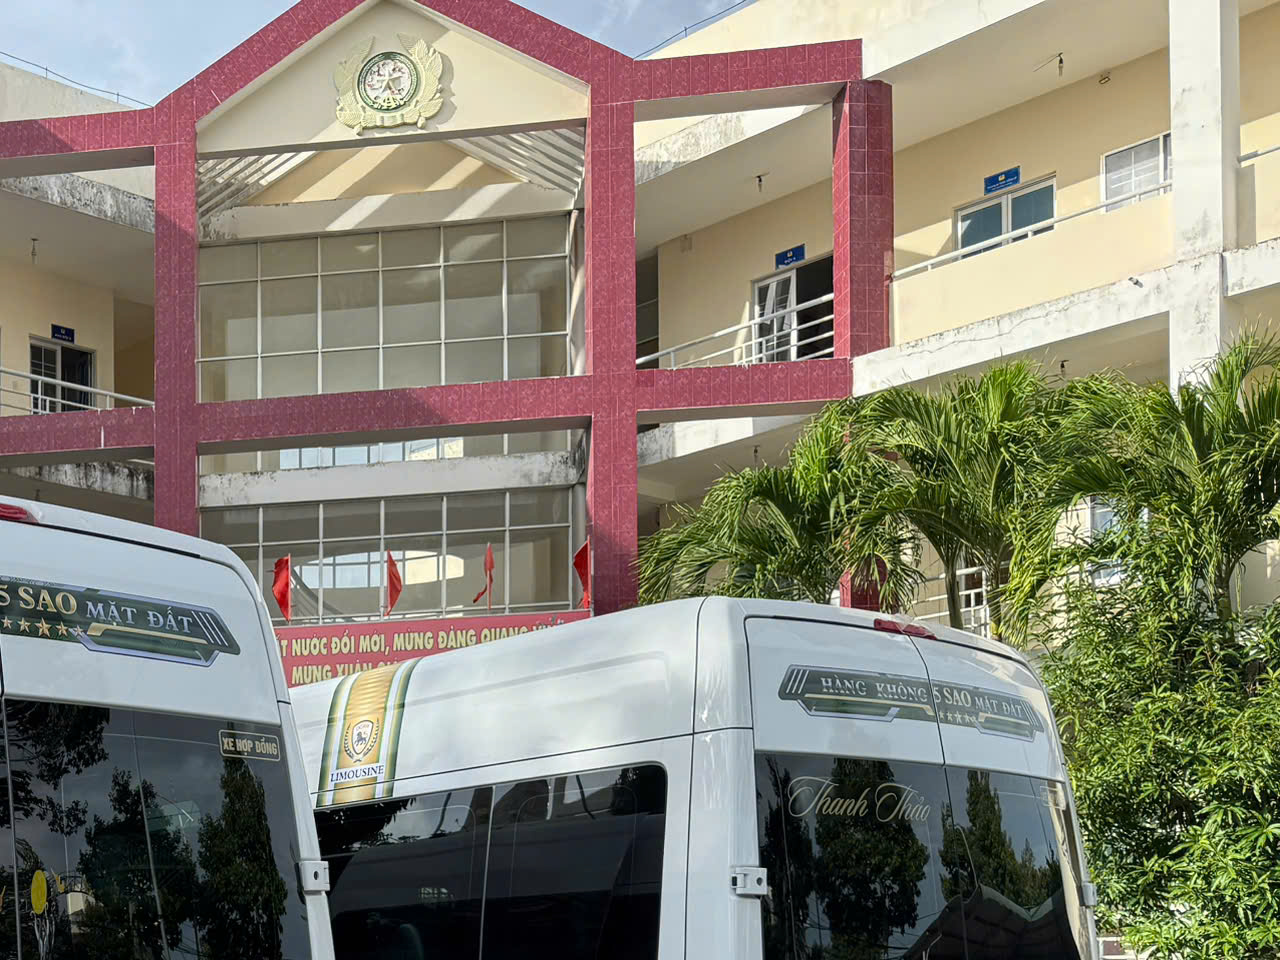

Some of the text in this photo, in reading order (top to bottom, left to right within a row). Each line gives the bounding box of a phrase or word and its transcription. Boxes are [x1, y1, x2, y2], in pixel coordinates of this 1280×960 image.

[17, 585, 78, 615] SAO
[86, 600, 137, 626] MẶT
[147, 606, 193, 633] ĐẤT
[292, 633, 328, 657] NƯỚC
[331, 629, 355, 654] ĐỔI
[359, 630, 390, 656] MỚI,
[393, 628, 434, 651] MỪNG
[438, 626, 477, 649] ĐẢNG
[292, 661, 332, 685] MỪNG
[820, 674, 867, 696] HÀNG
[876, 680, 928, 704] KHÔNG
[944, 687, 972, 708] SAO
[222, 737, 278, 756] XE HỢP ĐỒNG
[330, 764, 385, 783] LIMOUSINE
[787, 776, 870, 818] Thanh
